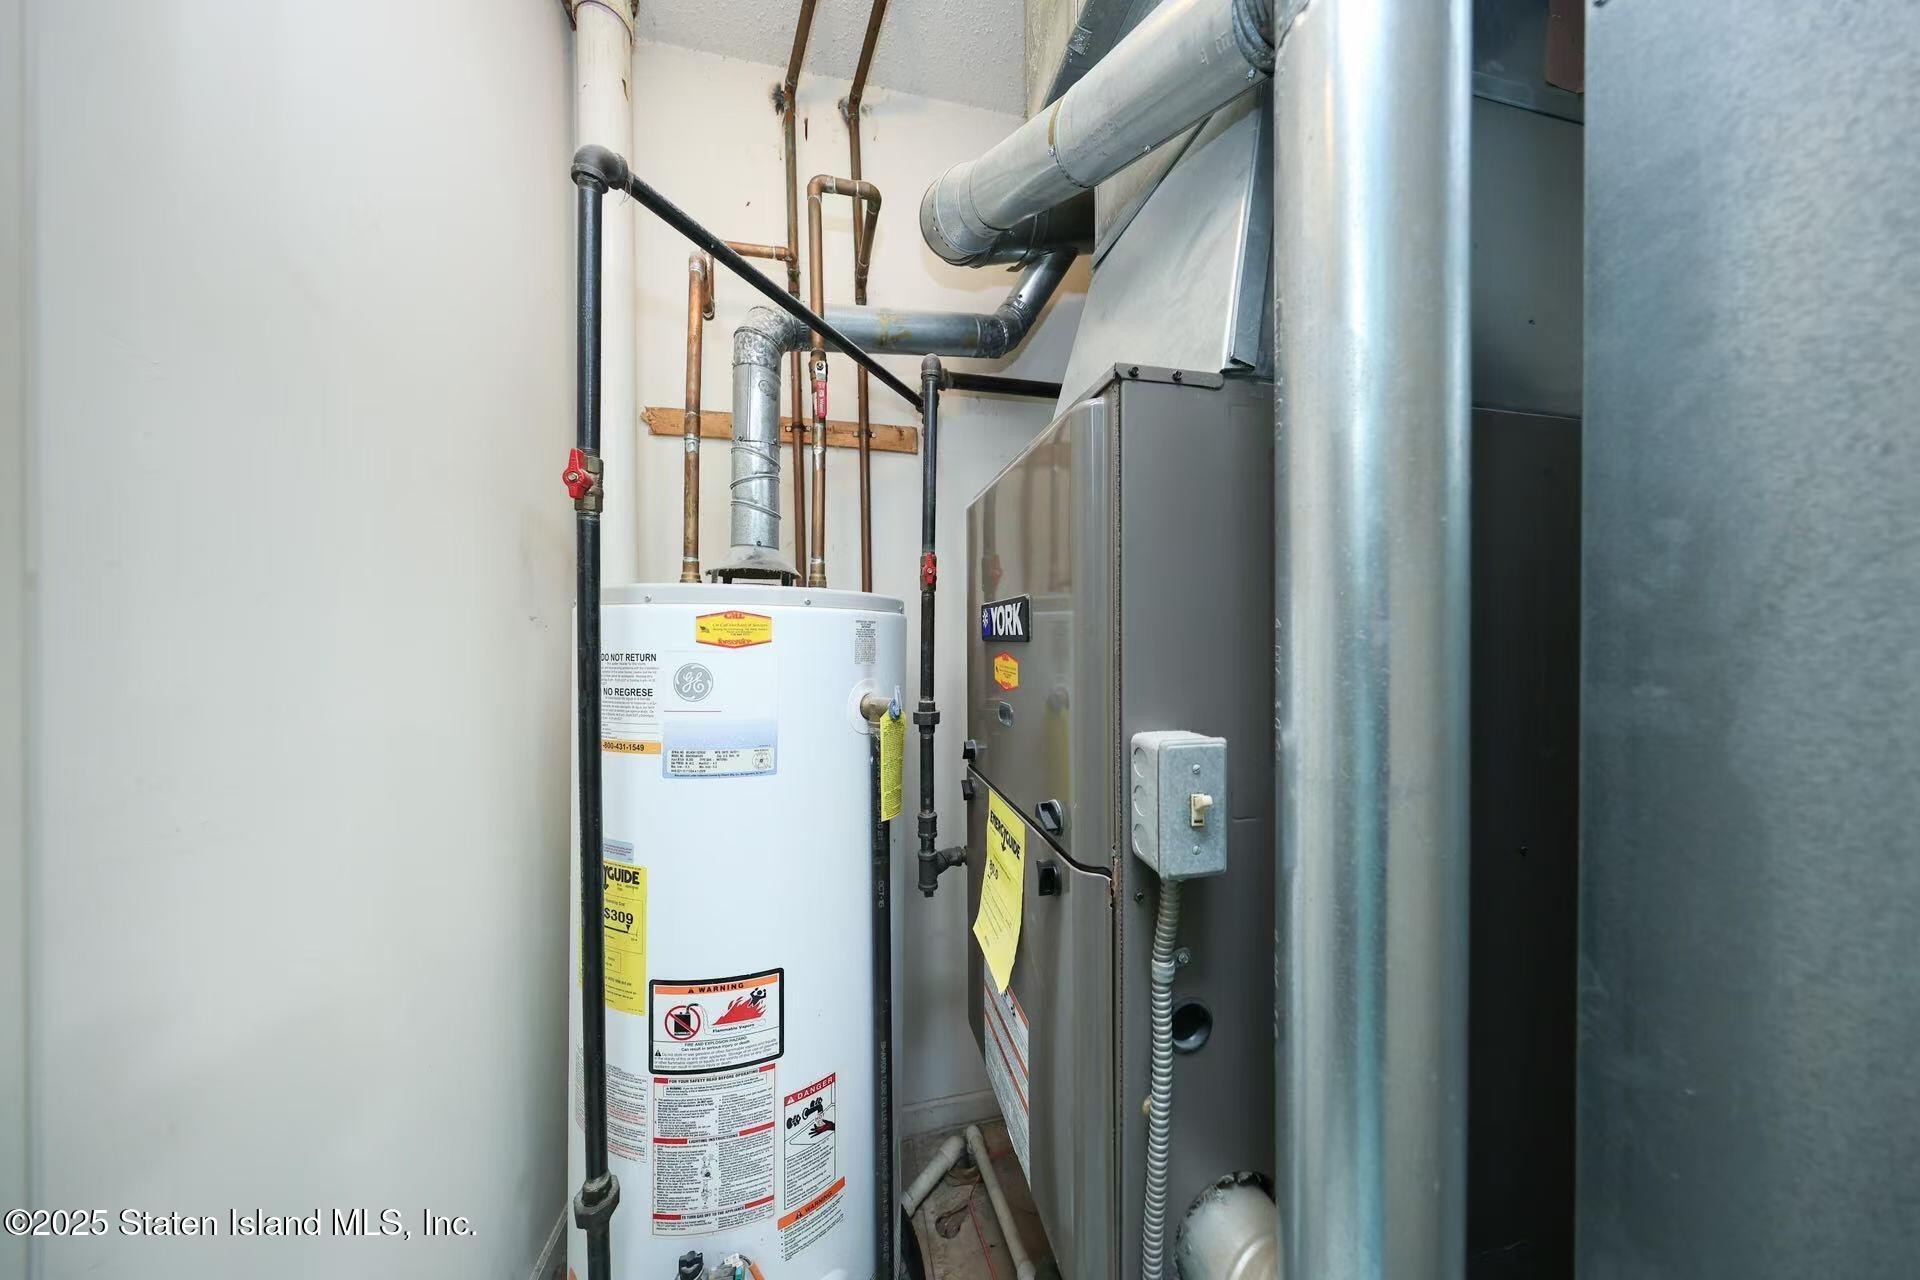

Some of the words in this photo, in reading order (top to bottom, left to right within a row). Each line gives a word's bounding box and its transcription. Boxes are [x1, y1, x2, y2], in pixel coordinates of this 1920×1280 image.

[990, 602, 1023, 636] YORK
[610, 653, 624, 662] NOT
[625, 653, 657, 662] RETURN
[603, 687, 613, 696] NO
[614, 687, 653, 697] REGRESE
[698, 983, 744, 992] WARNING
[735, 1069, 758, 1078] OPERATING
[797, 1076, 833, 1100] DANGER
[708, 1133, 738, 1142] INSTRUCTIONS
[805, 1190, 833, 1213] WARNING
